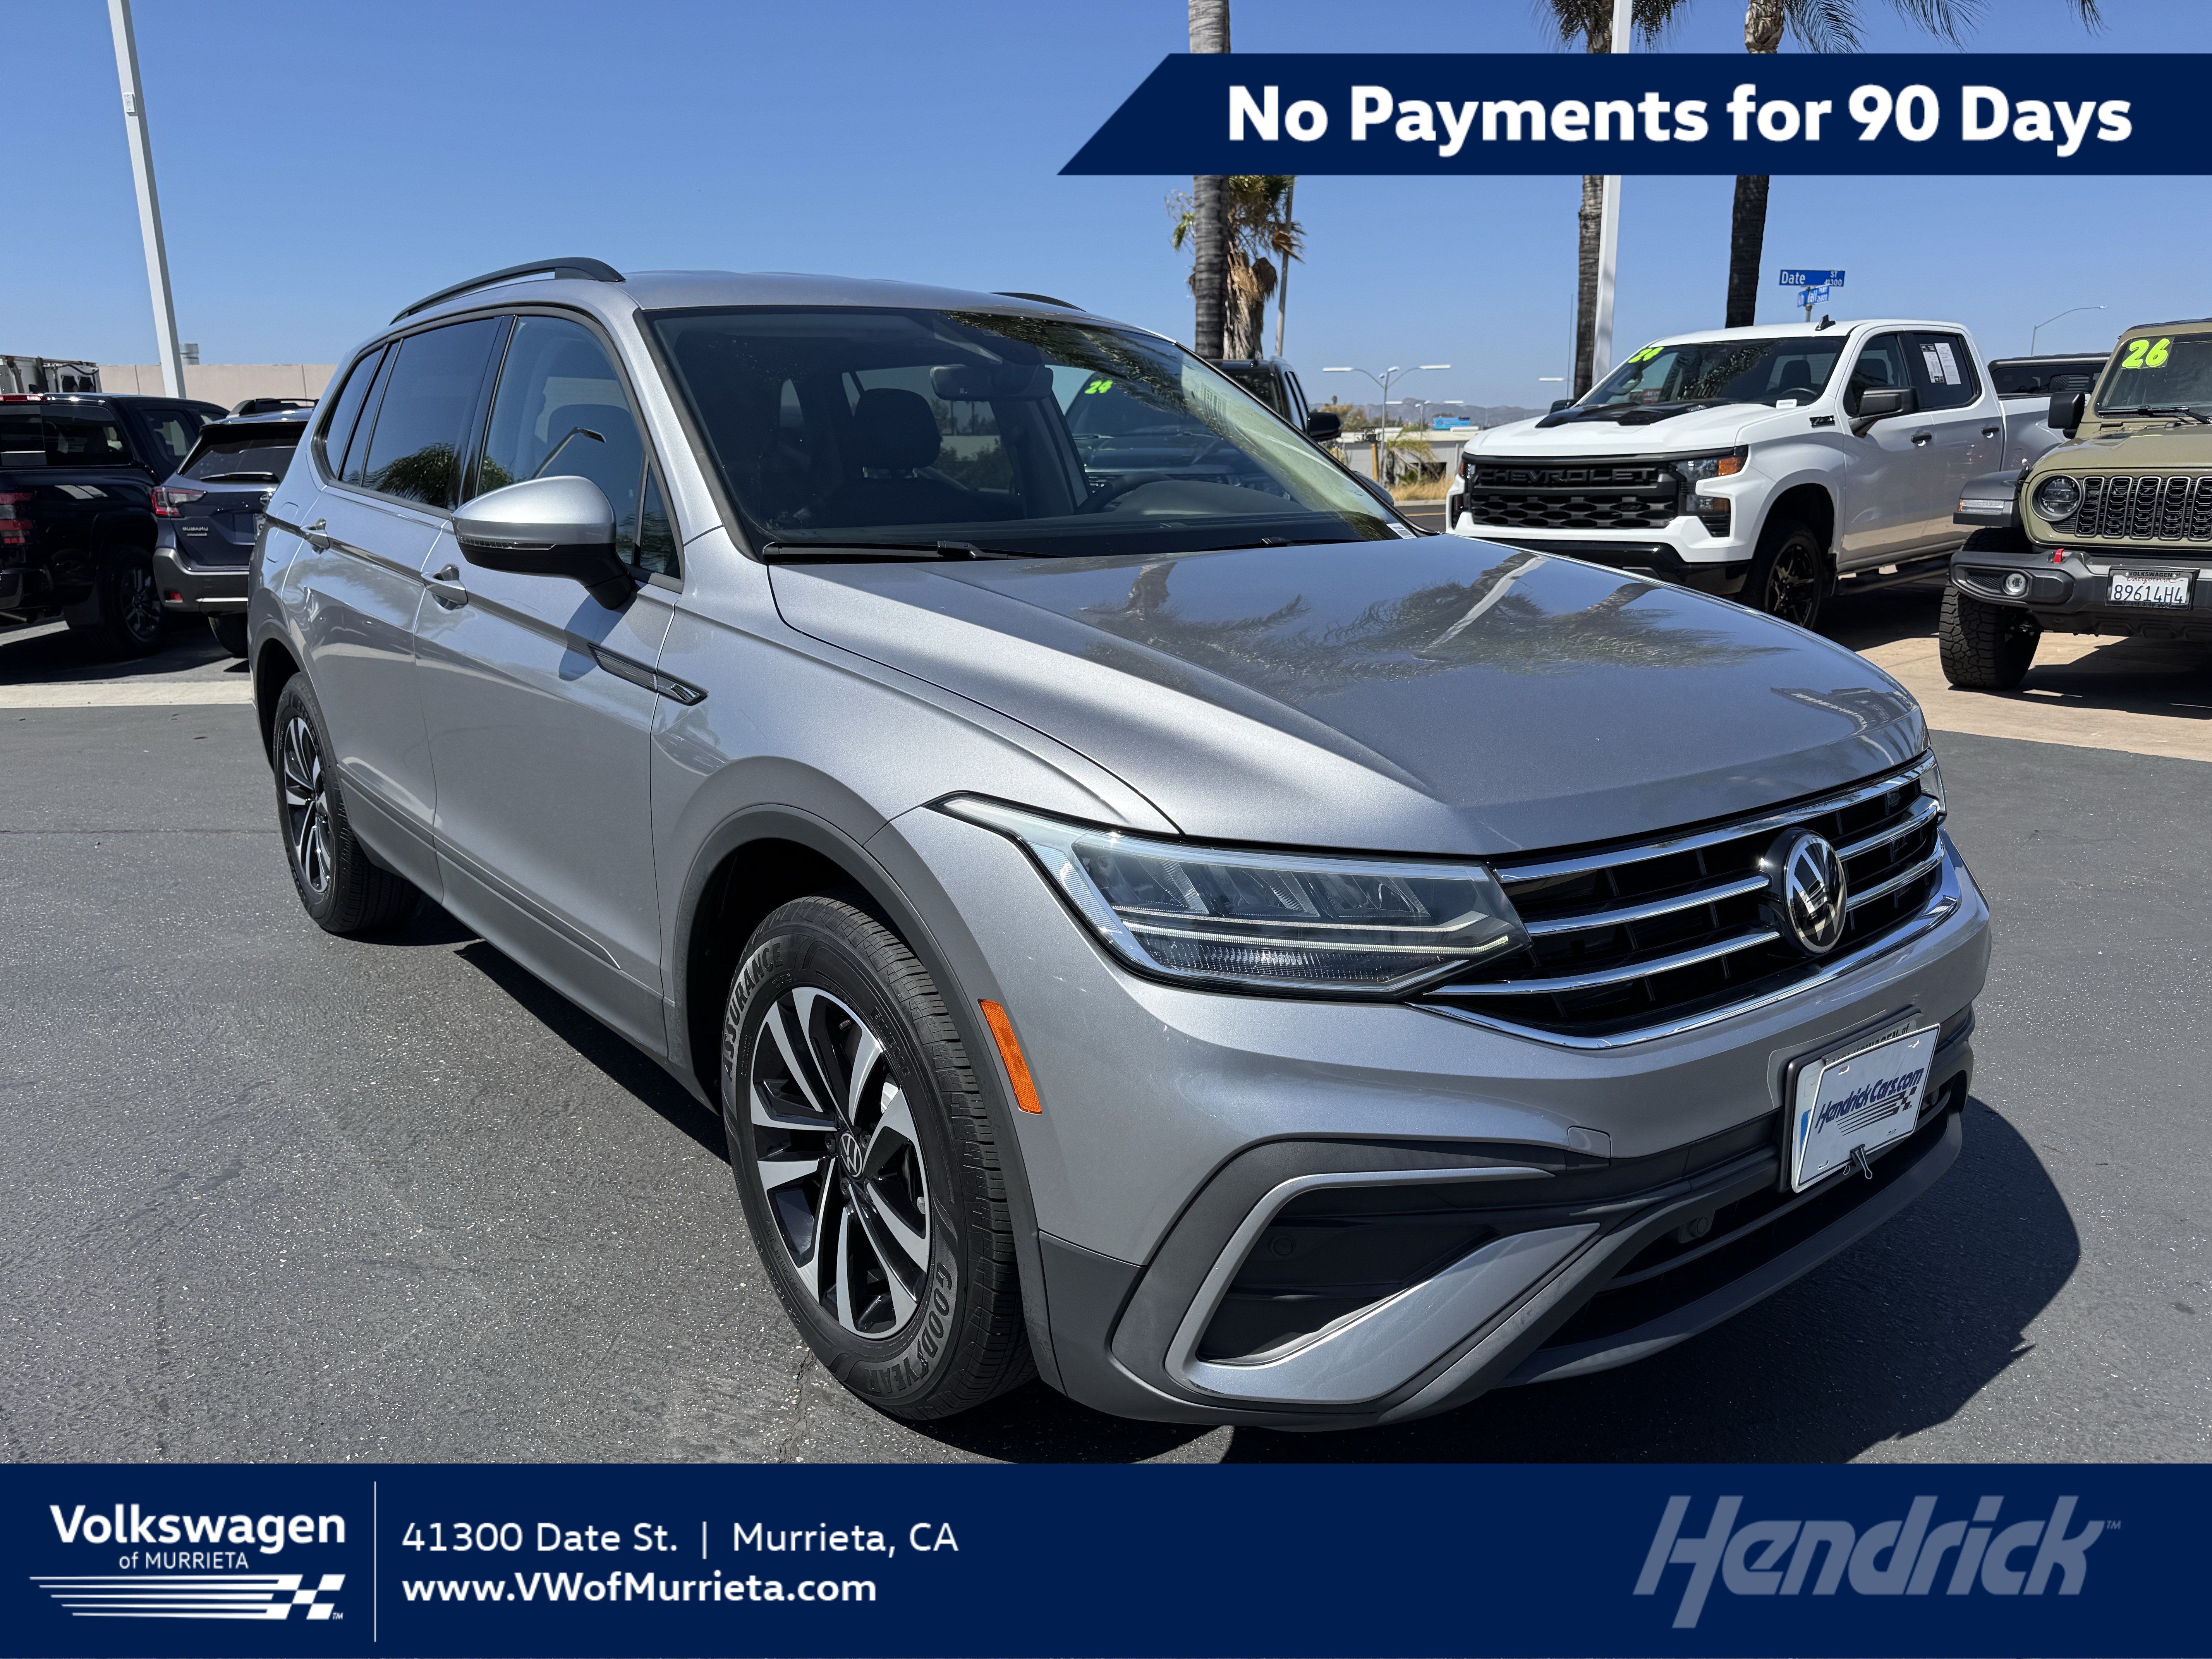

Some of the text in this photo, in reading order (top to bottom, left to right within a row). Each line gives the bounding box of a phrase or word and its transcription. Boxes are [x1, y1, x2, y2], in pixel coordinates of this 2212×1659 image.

[1781, 271, 1805, 284] Date
[2122, 338, 2170, 369] 26
[1479, 468, 1656, 483] CHEVROLET
[2114, 584, 2183, 603] 89614H4
[723, 942, 783, 1083] ASSURANCE
[871, 1006, 910, 1078] FINESSE
[1814, 1068, 1925, 1134] HendrickCars.com
[864, 1262, 952, 1393] GOODYEAR
